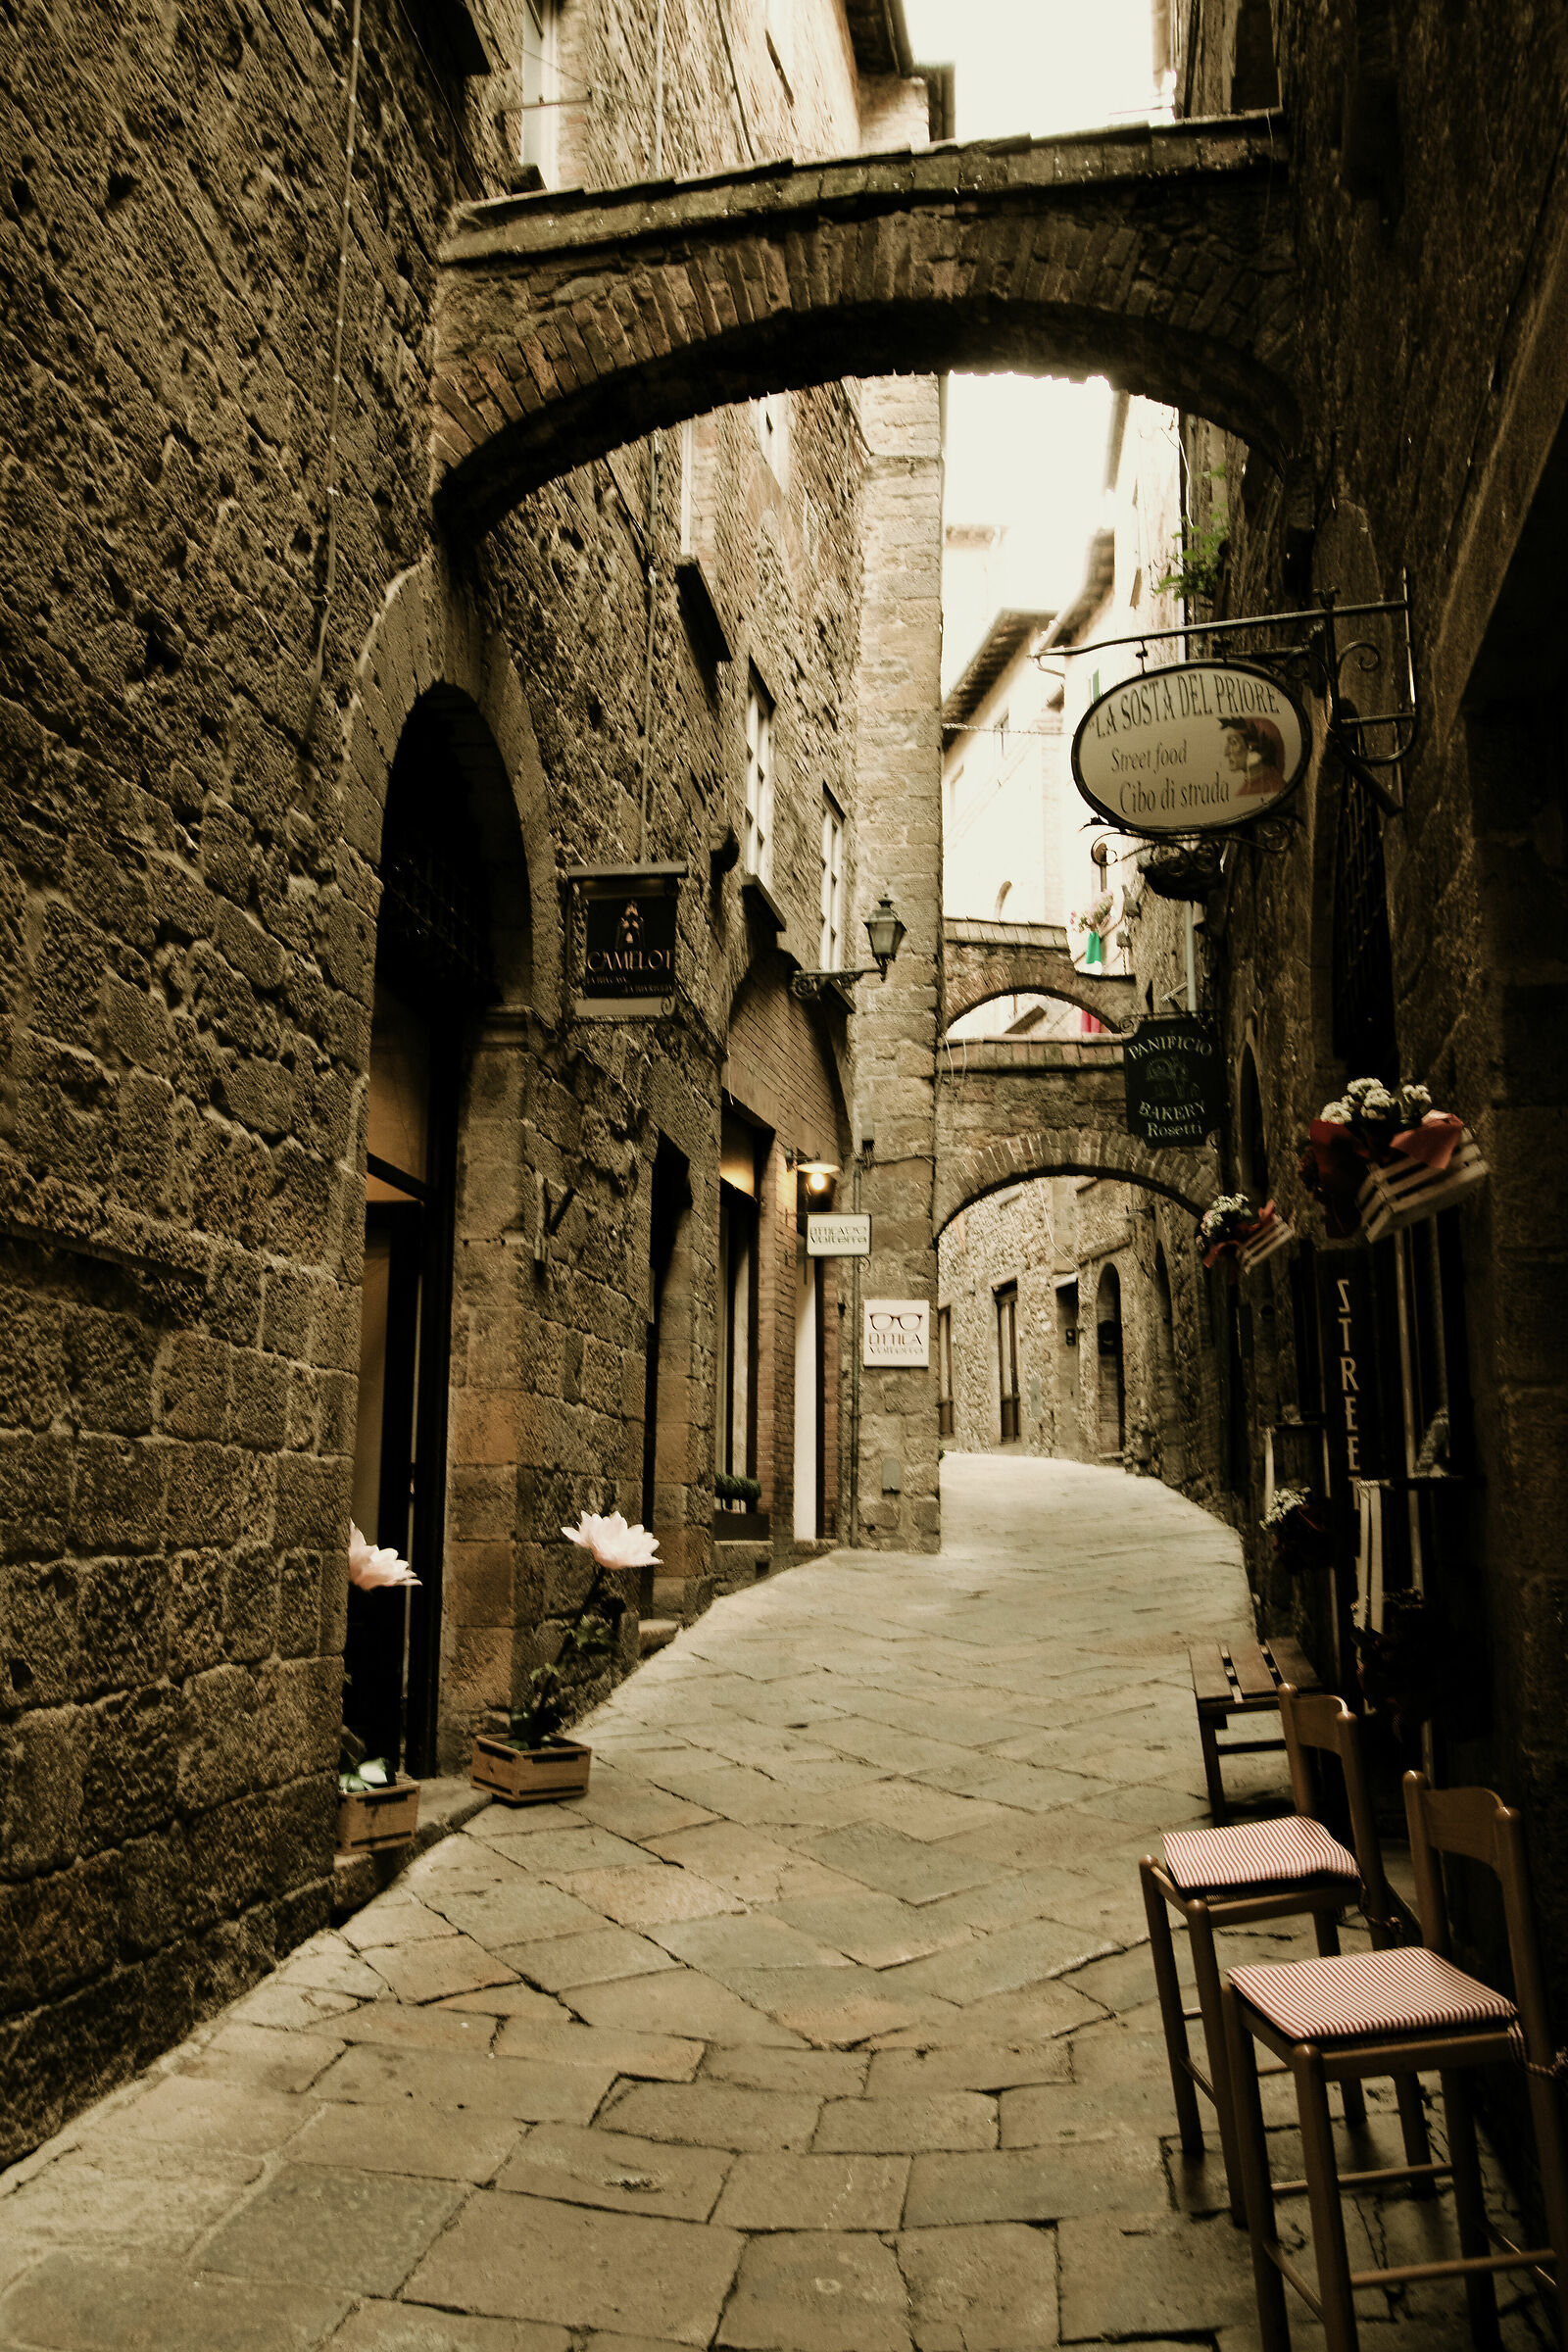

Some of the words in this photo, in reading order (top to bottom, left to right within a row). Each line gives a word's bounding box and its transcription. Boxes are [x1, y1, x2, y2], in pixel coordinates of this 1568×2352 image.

[1121, 677, 1175, 731] SOSTA
[1177, 673, 1213, 719] DEL
[1214, 673, 1280, 714] PRIORE
[1111, 747, 1151, 772] Street
[1153, 739, 1187, 774] food
[1120, 780, 1155, 814] Cibo
[1160, 777, 1175, 810] di
[1180, 771, 1229, 808] strada
[587, 949, 674, 972] CAMELOT
[1128, 1035, 1212, 1059] PANIFICIO
[1139, 1100, 1205, 1120] BAKERY
[1147, 1121, 1202, 1138] Rosetti
[1337, 1279, 1361, 1510] STREET
